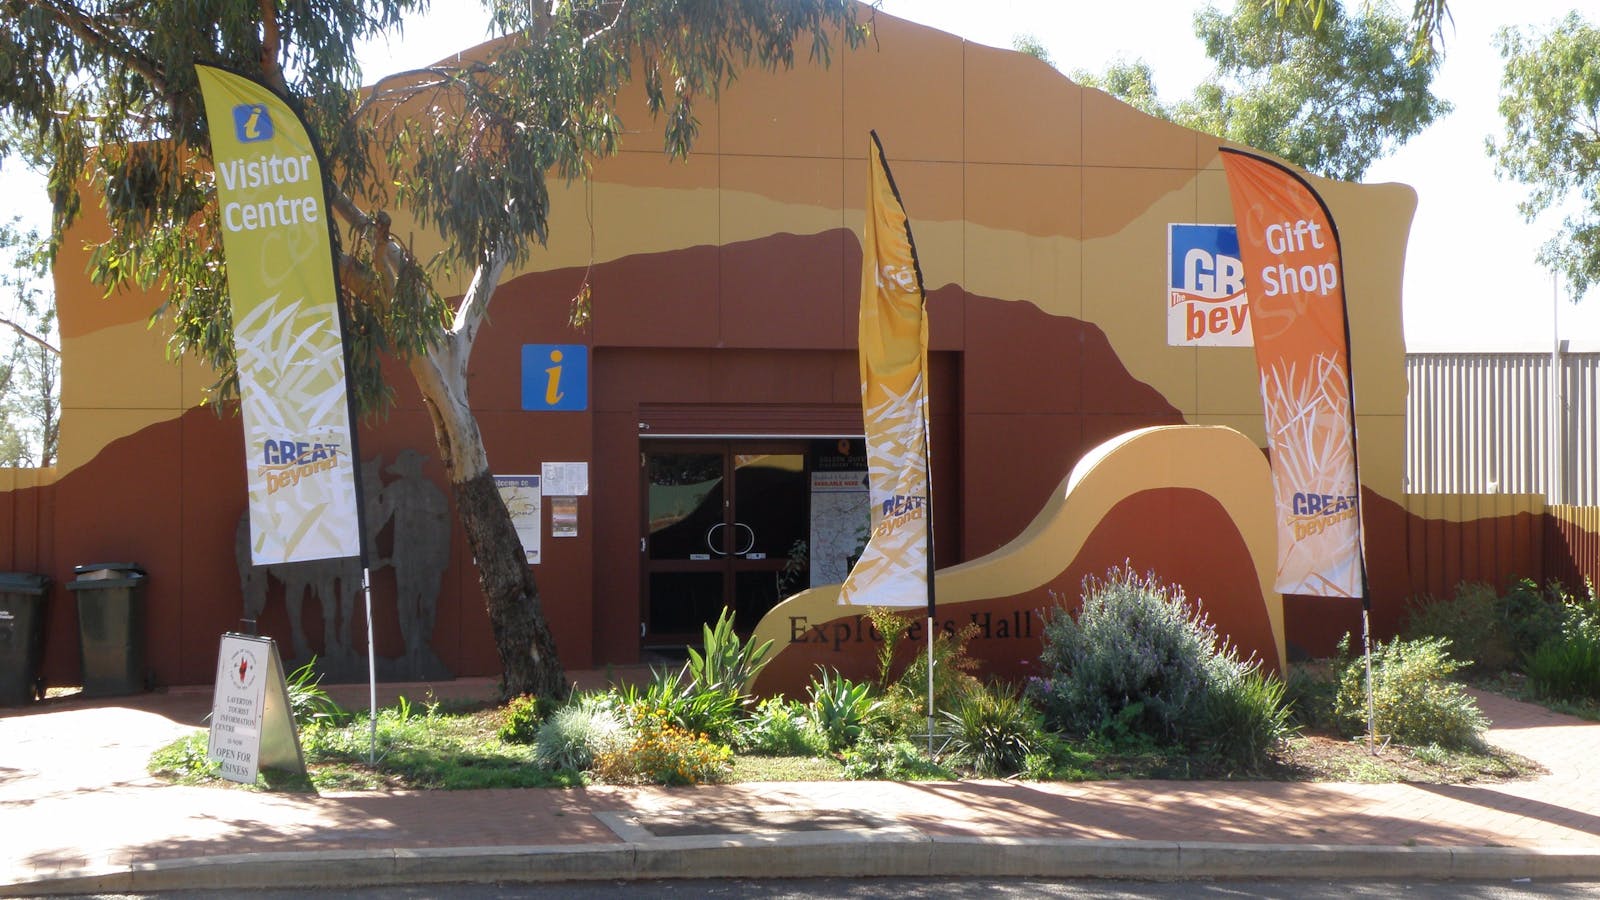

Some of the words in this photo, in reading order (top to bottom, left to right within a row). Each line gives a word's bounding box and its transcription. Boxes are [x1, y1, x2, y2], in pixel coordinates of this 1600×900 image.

[219, 154, 312, 190] Visitor
[224, 195, 318, 232] Centre
[1265, 219, 1325, 255] Gift
[1262, 262, 1338, 297] Shop
[263, 439, 340, 466] GREAT
[265, 455, 338, 496] beyond
[1293, 492, 1358, 515] GREAT
[1295, 507, 1358, 542] beyond
[970, 610, 1033, 640] Hall
[226, 696, 252, 705] LAVERTON
[228, 705, 249, 715] TOURIST
[215, 723, 235, 732] CENTRE
[220, 714, 255, 727] INFORMATION
[216, 747, 235, 759] OPEN
[236, 751, 252, 763] FOR
[223, 761, 249, 776] SINESS
